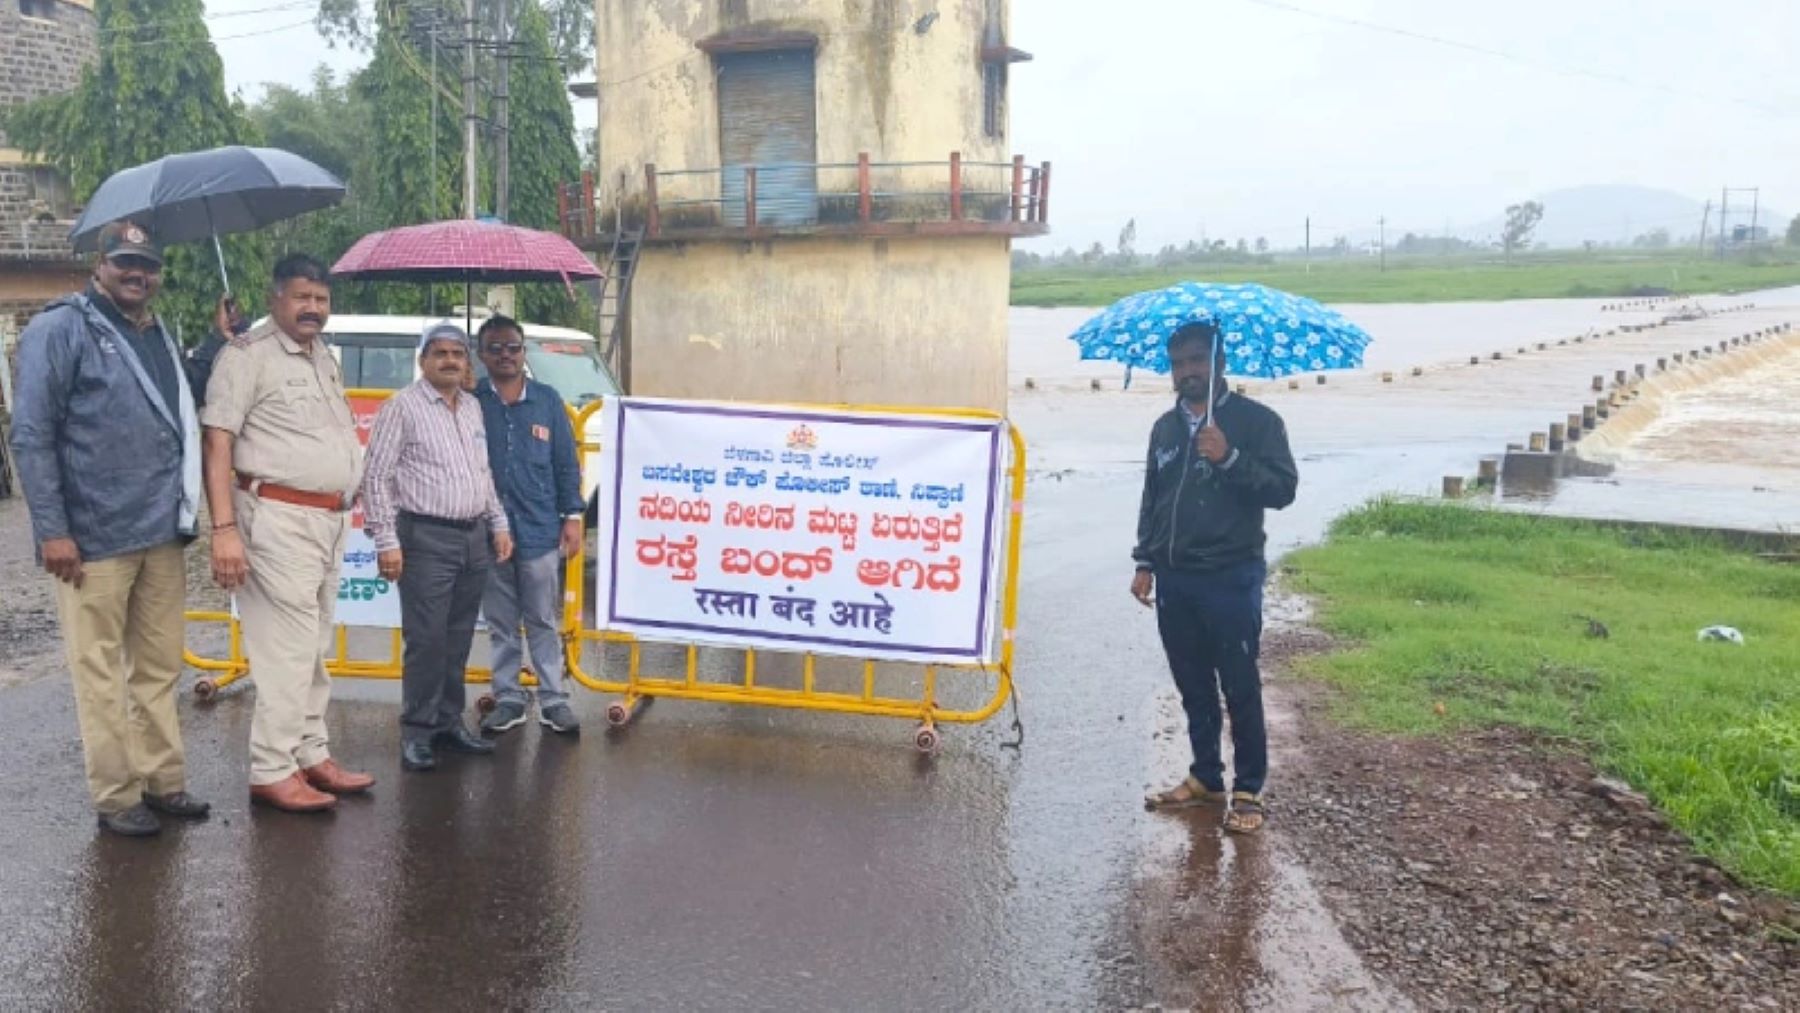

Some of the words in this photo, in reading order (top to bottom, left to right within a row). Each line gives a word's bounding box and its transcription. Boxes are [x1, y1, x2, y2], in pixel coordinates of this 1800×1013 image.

[639, 493, 711, 523] ನದಿಯ
[724, 501, 795, 531] ನೀರಿನ
[808, 505, 858, 551] ಮಟ್ಟ
[871, 511, 963, 552] ಏರುತ್ತಿದೆ
[636, 533, 698, 581] ರಸ್ತೆ
[720, 544, 833, 580] ಬಂದ್
[857, 554, 961, 592] ಆಗಿದೆ
[694, 587, 758, 619] रस्ता
[769, 585, 816, 628] बंद
[829, 592, 894, 635] आहे
